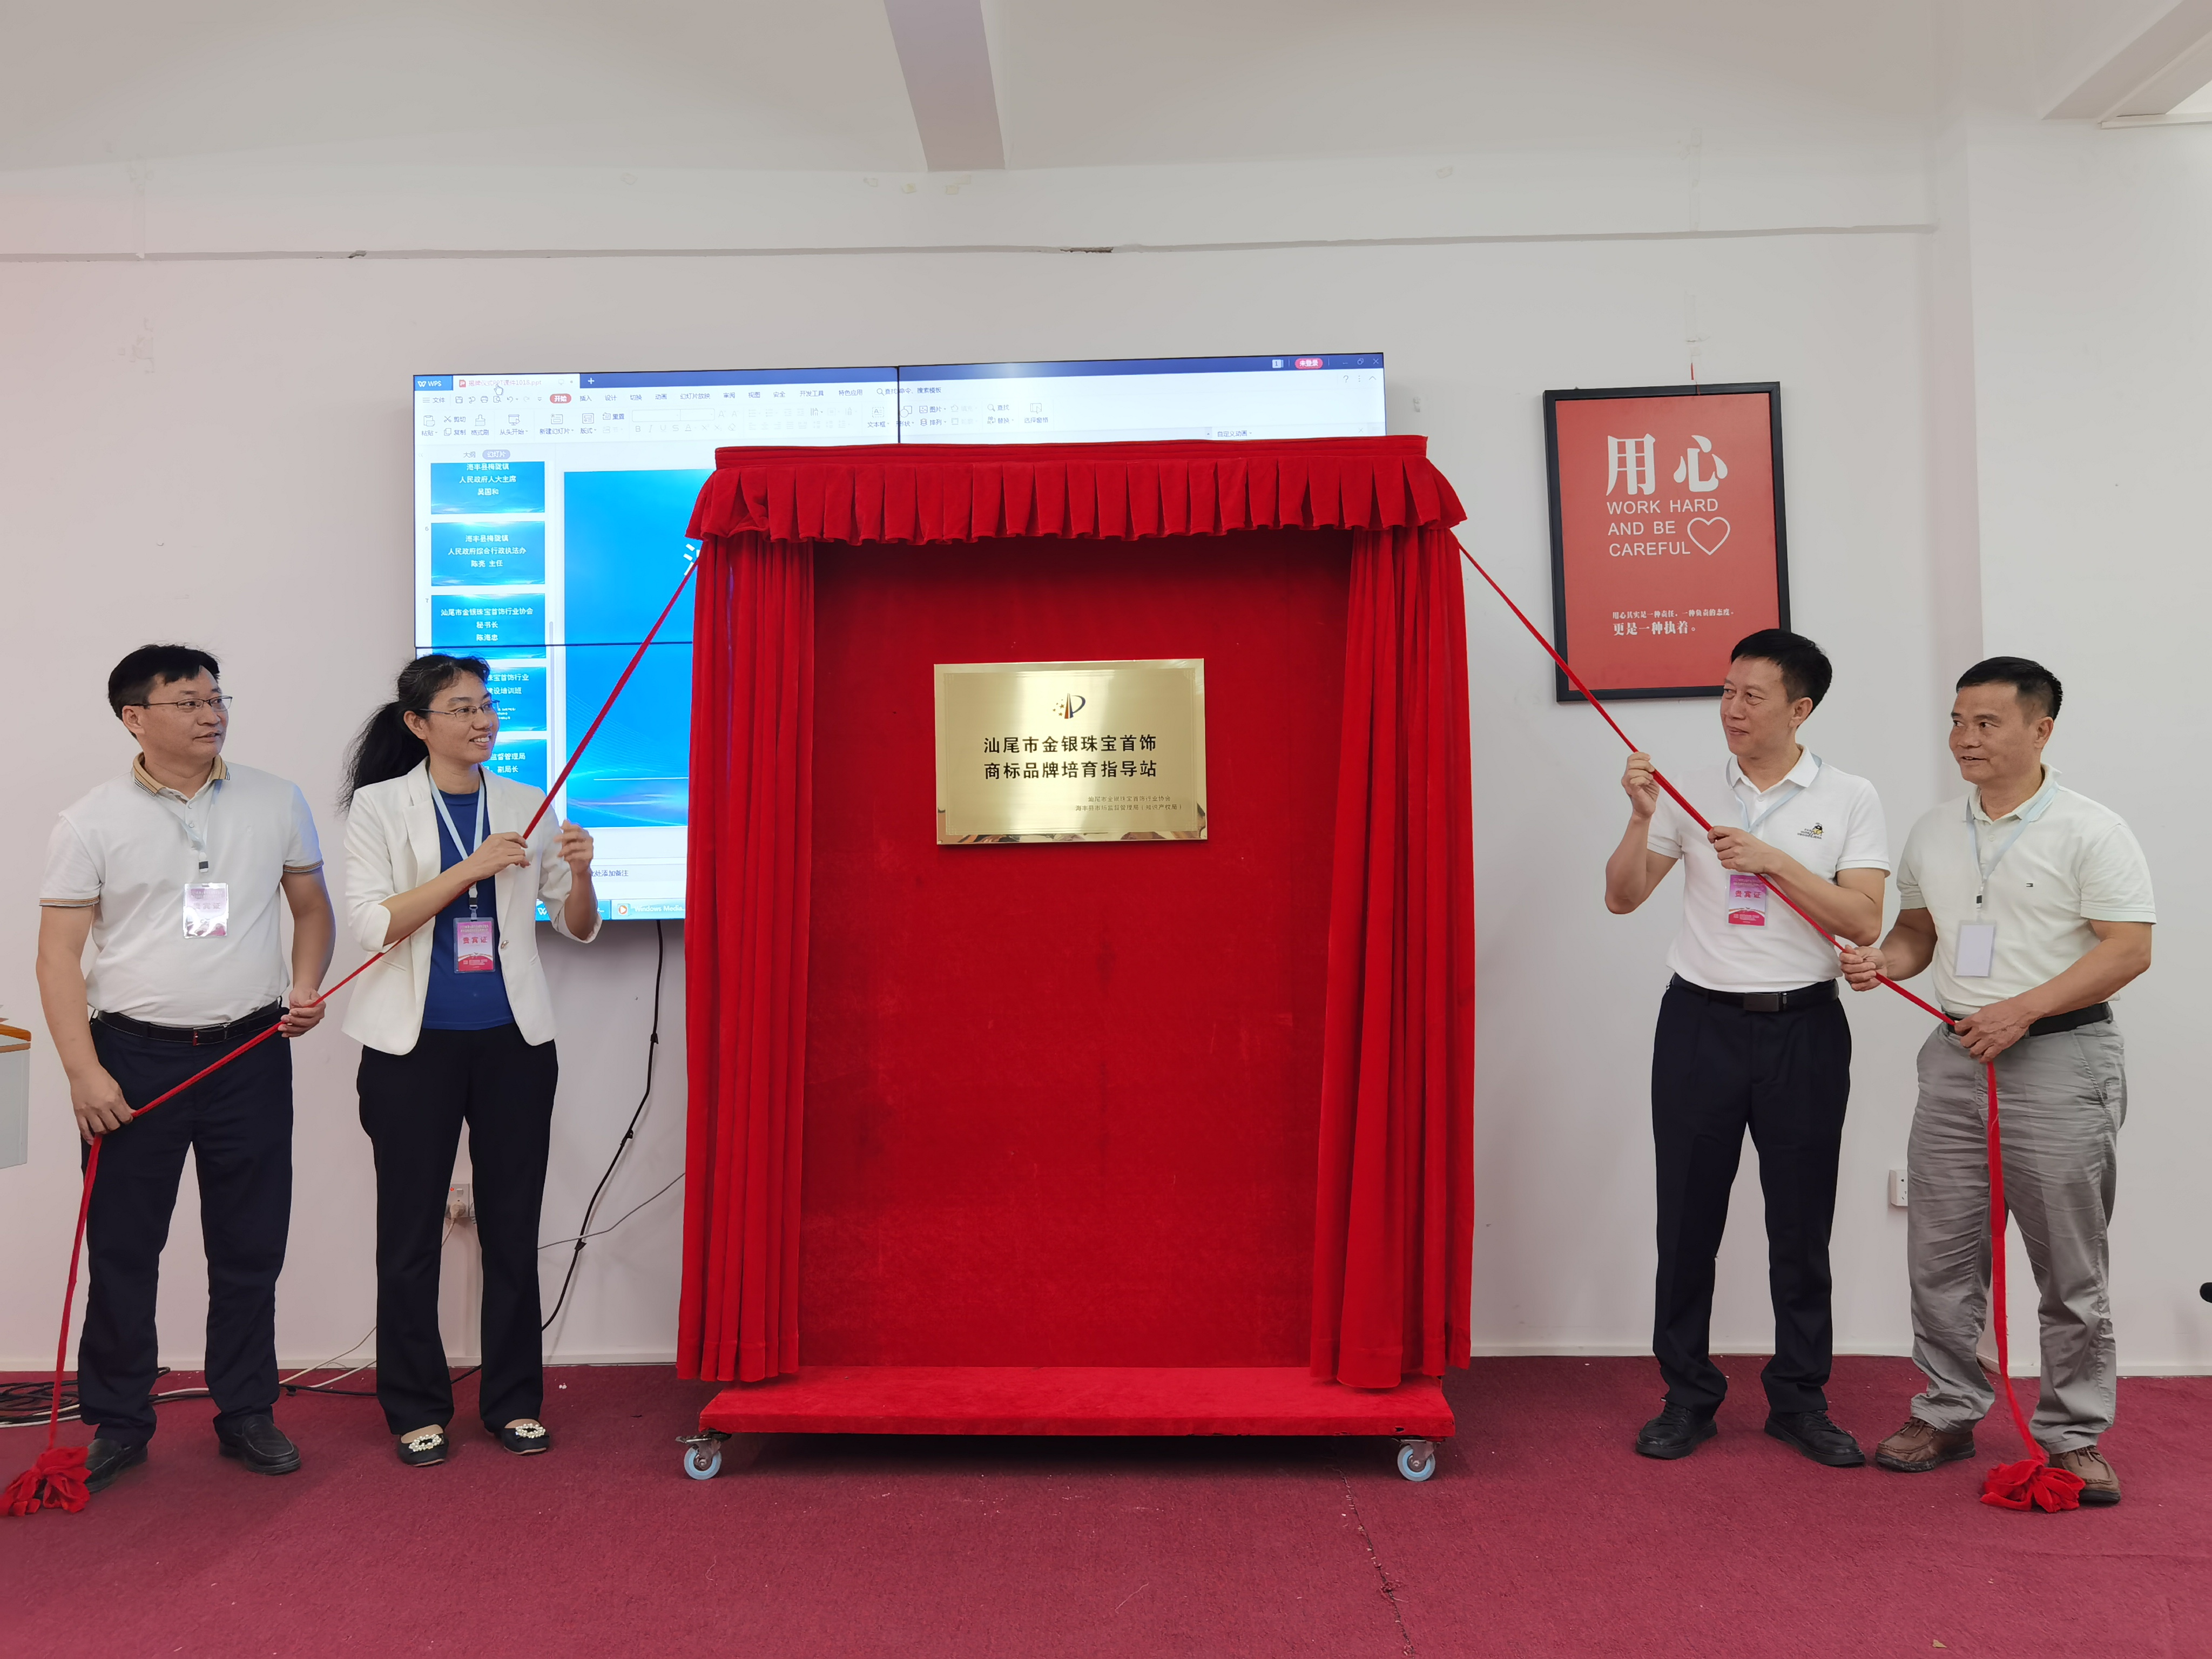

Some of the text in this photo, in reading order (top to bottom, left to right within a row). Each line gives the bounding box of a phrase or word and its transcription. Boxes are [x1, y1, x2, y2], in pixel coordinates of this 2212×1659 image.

[466, 463, 509, 471] 海丰县梅陇镇
[1606, 433, 1728, 496] 用心
[459, 476, 516, 484] 人民政府人大主席
[1607, 498, 1718, 515] WORK HARD
[1608, 520, 1676, 536] AND BE
[465, 535, 509, 543] 海丰县梅陇镇
[448, 548, 527, 556] 人民政府综合行政执法办
[1609, 541, 1691, 557] CAREFUL
[441, 608, 534, 617] 汕尾市金银珠宝首饰行业协会
[1613, 621, 1696, 636] 更是一种执着。
[983, 734, 1157, 754] 汕尾市金银珠宝首饰
[983, 760, 1157, 780] 商标品牌培育指导站
[1735, 890, 1761, 899] 贵宾证
[463, 936, 488, 945] 贵宾证
